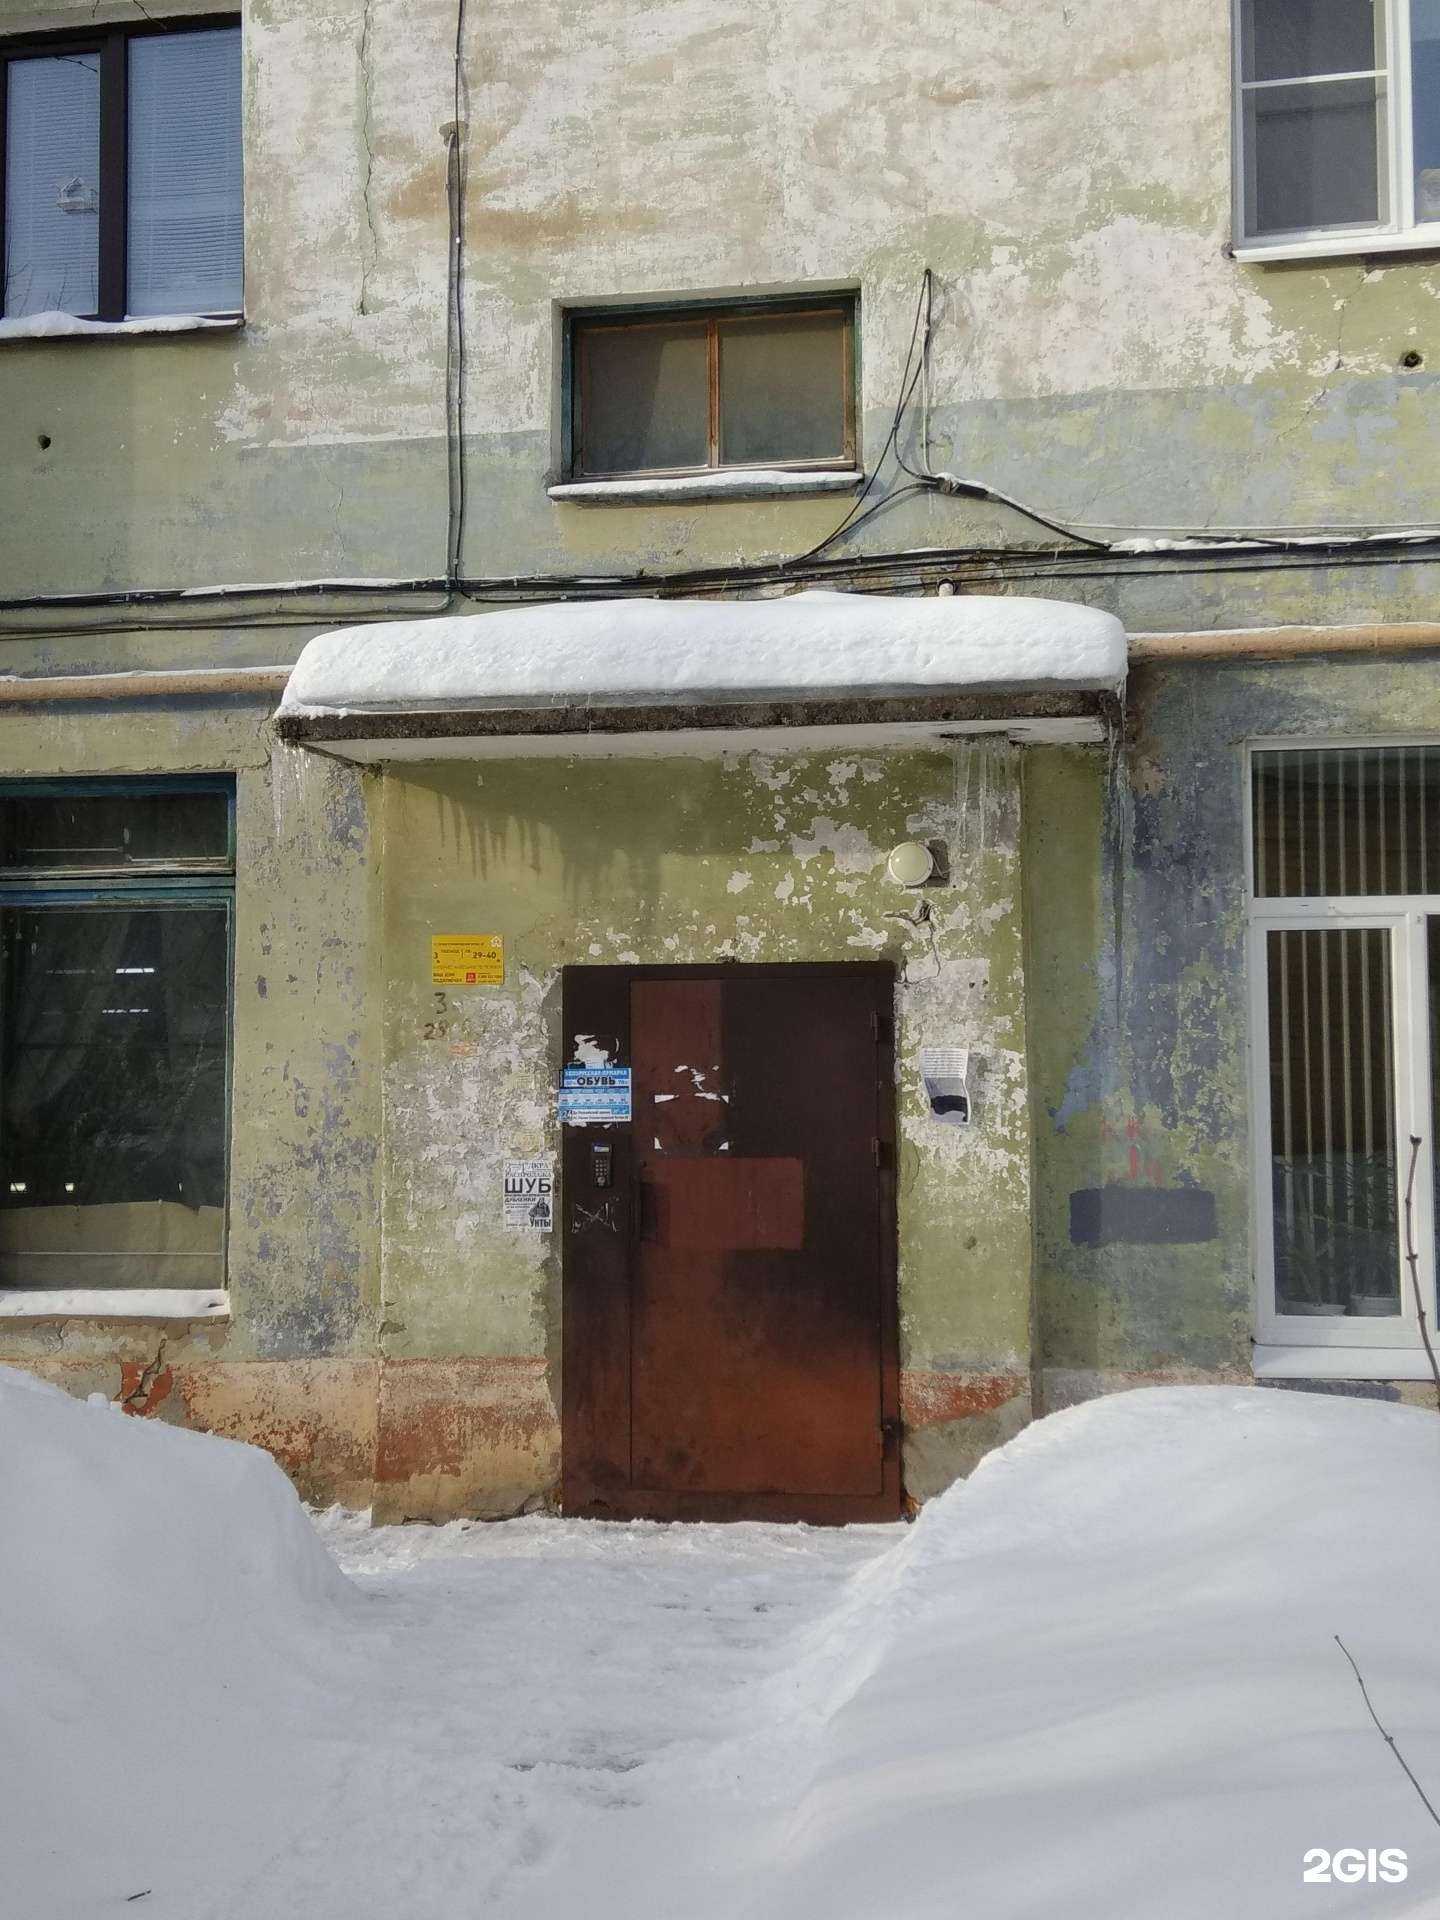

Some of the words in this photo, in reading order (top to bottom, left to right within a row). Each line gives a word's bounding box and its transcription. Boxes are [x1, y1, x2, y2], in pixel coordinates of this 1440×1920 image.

[472, 951, 497, 959] 29-40
[434, 991, 447, 1014] 3
[577, 1076, 616, 1086] ОБУВЬ
[505, 1178, 551, 1193] ШУБ
